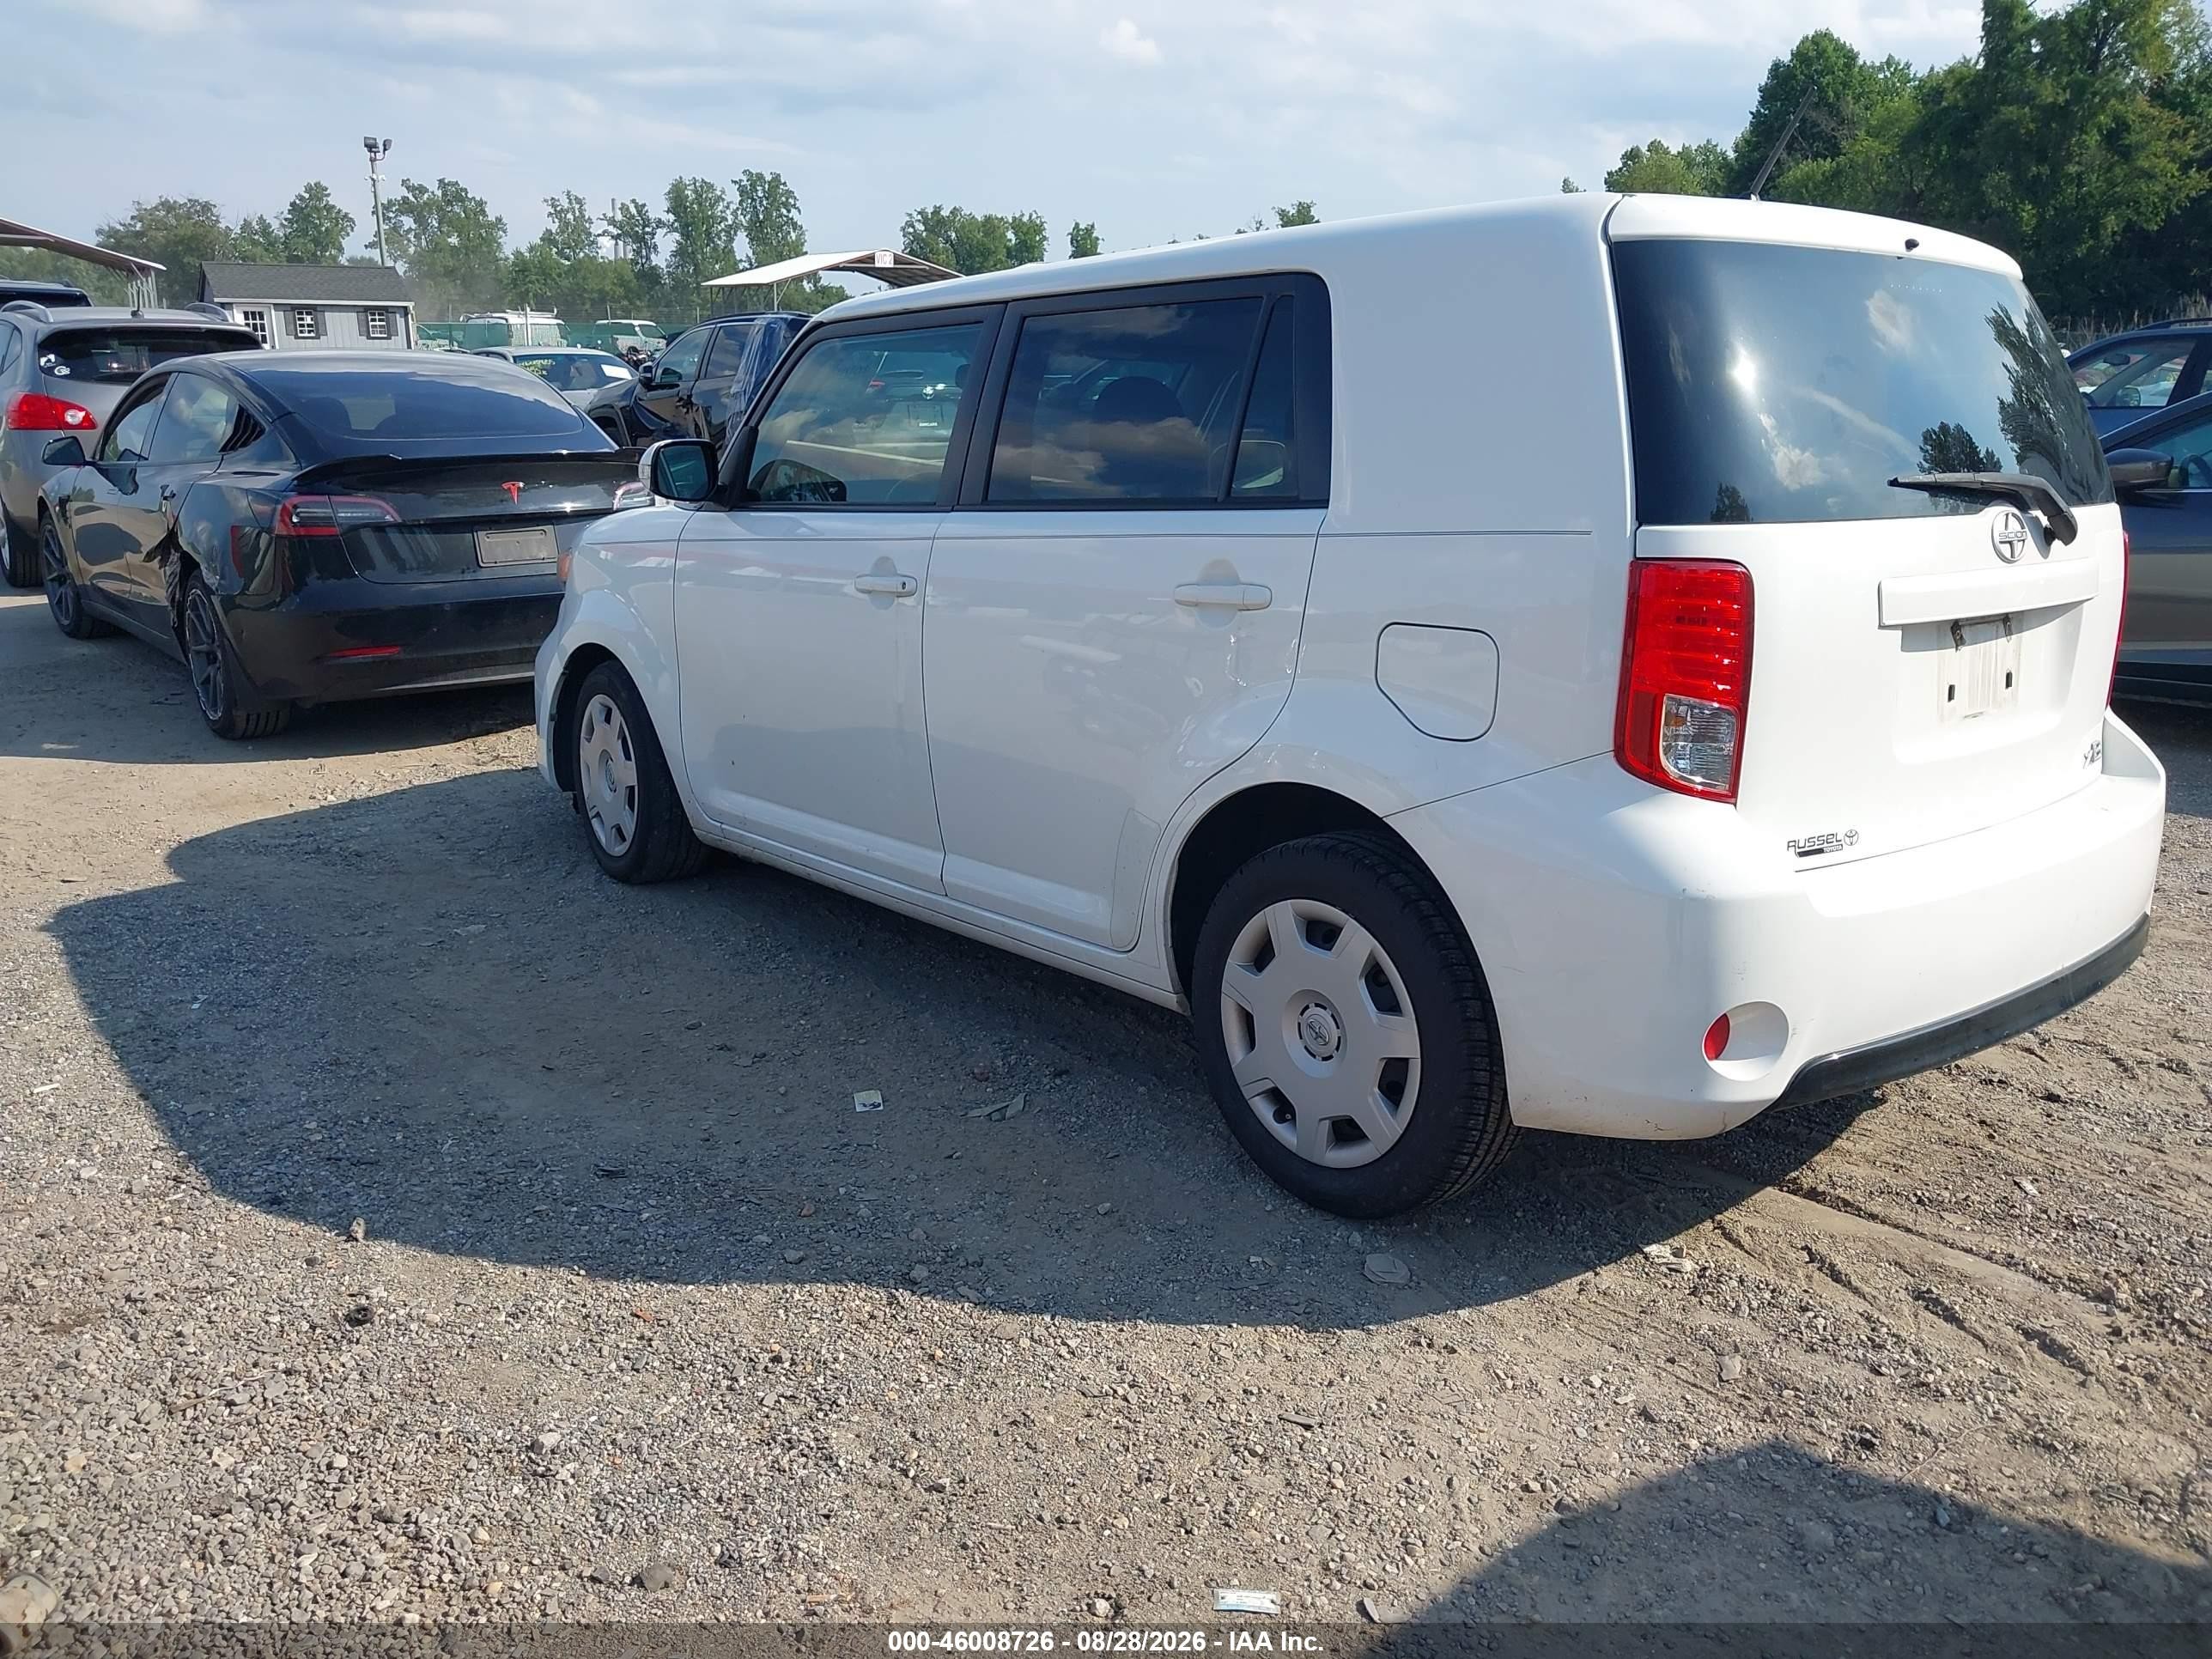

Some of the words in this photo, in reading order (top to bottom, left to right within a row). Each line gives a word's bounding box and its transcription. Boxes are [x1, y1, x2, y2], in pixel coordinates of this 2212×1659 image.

[876, 253, 888, 264] VIC
[889, 253, 893, 264] 2
[1998, 531, 2027, 540] SCION
[1787, 832, 1842, 858] RUSSEL
